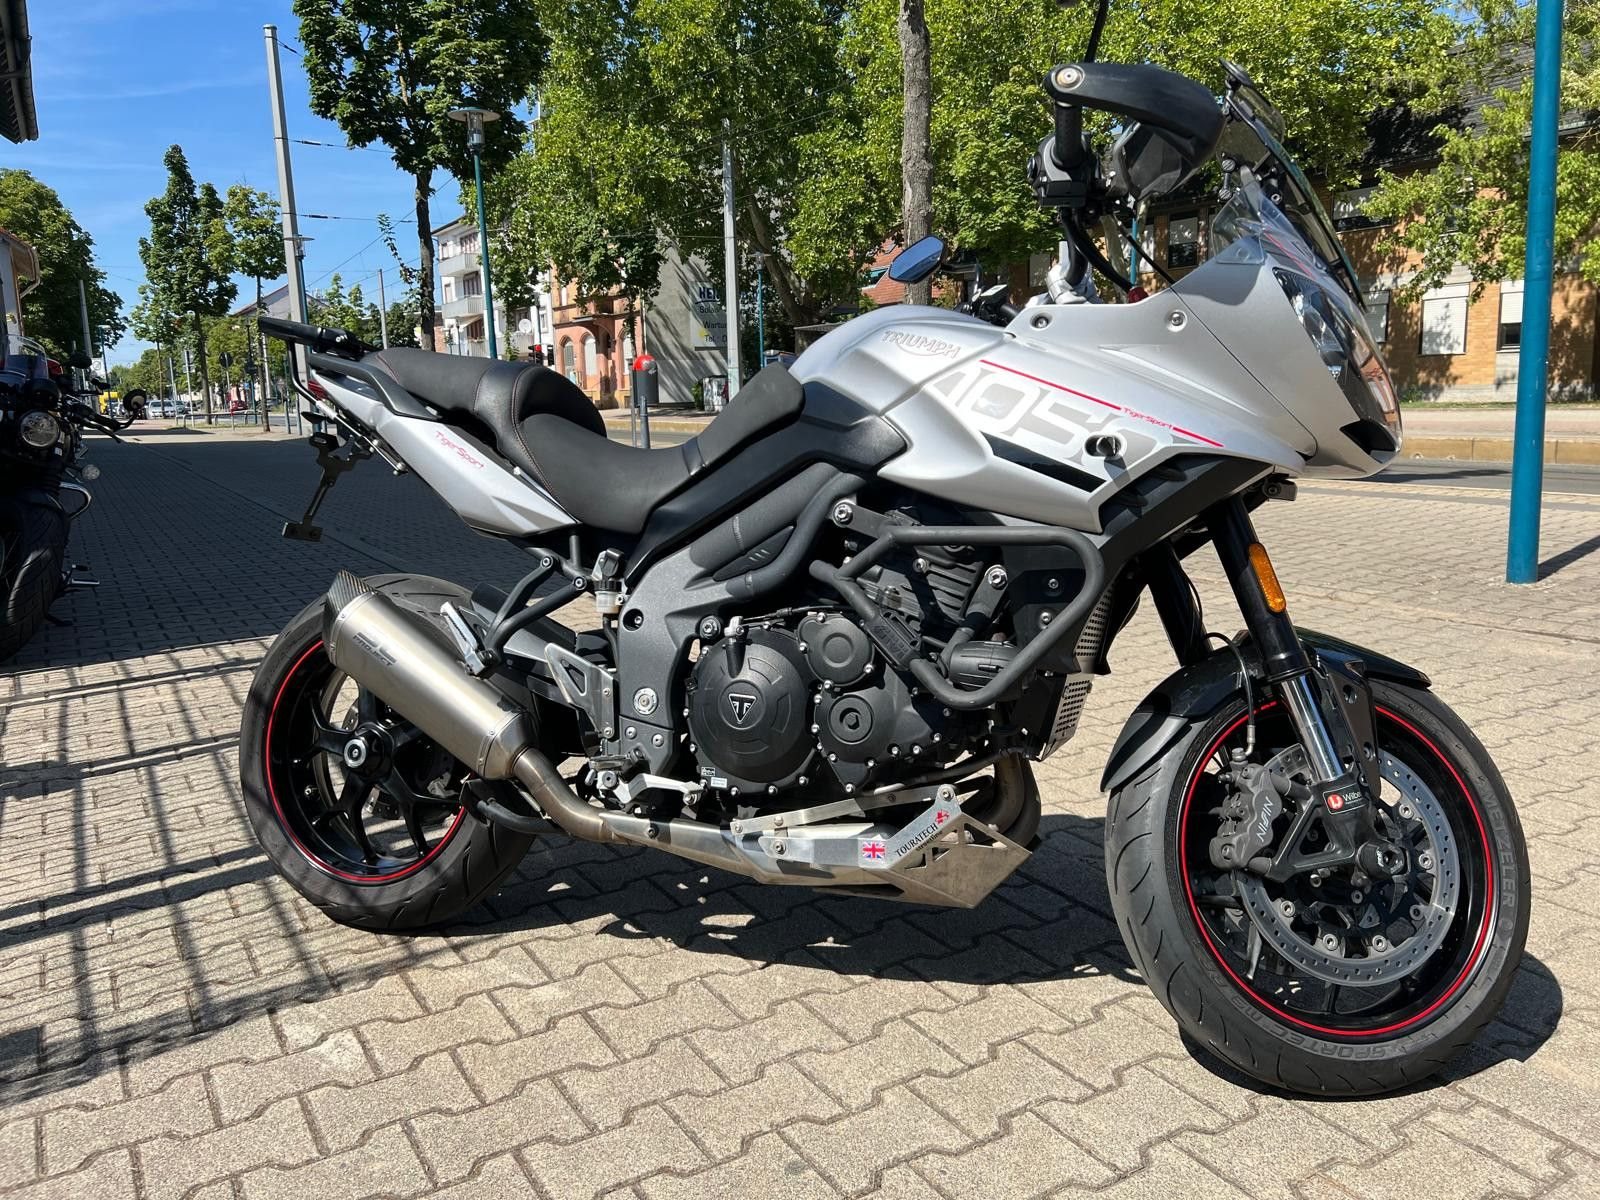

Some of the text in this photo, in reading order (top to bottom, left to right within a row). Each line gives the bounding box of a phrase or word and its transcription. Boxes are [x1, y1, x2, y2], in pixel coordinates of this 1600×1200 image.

[881, 330, 961, 359] TRIUMPH
[1124, 407, 1173, 430] TigerSport
[896, 823, 939, 857] TOURATECH
[1483, 793, 1517, 907] METZELER
[1263, 1023, 1390, 1060] SPORTEC
